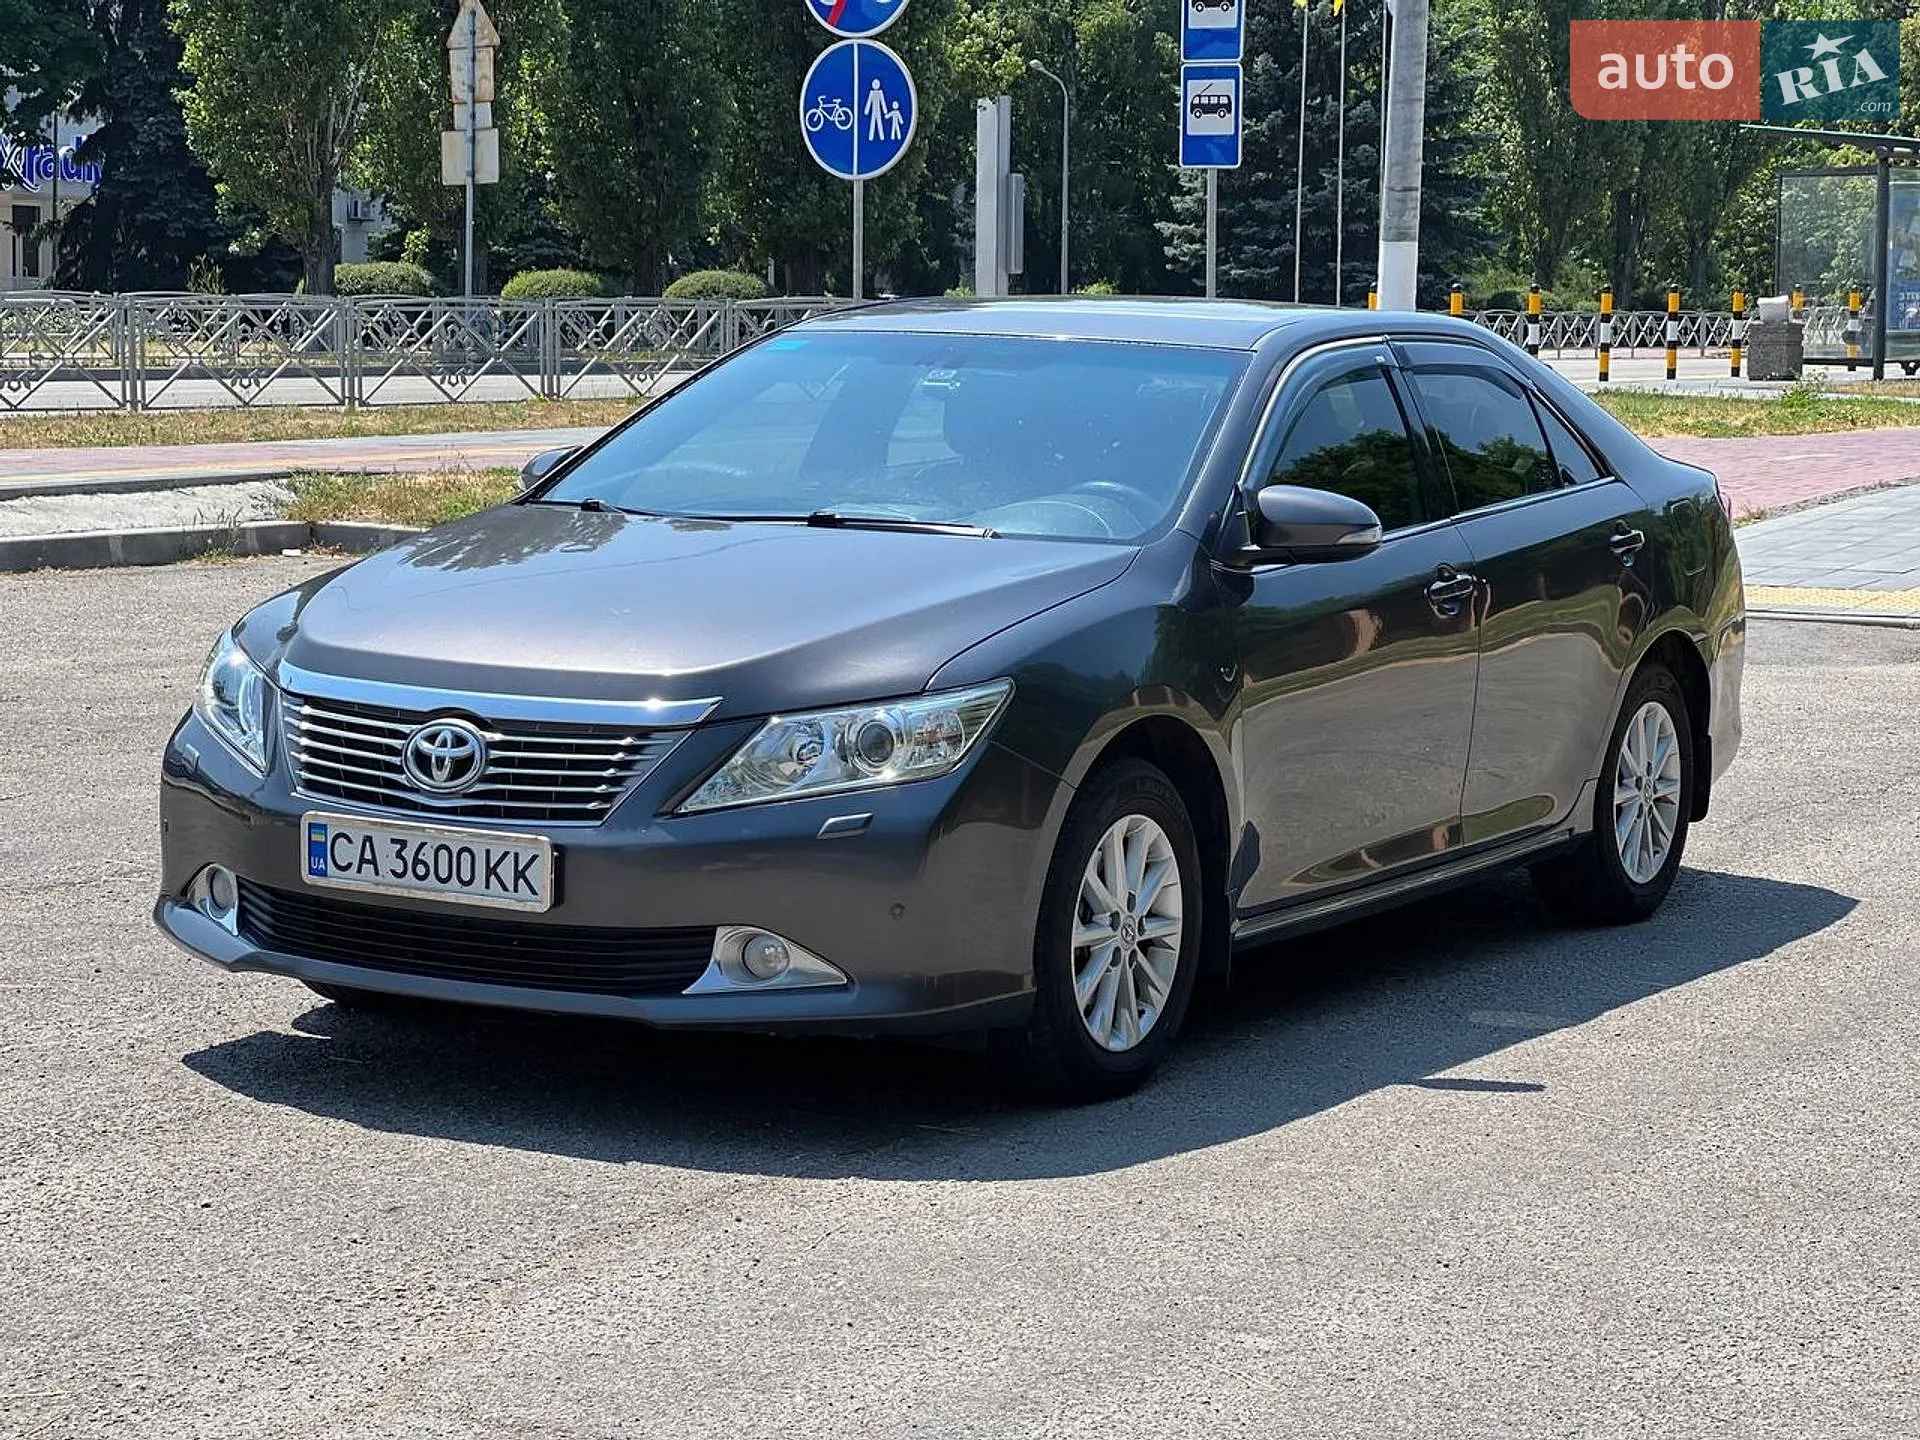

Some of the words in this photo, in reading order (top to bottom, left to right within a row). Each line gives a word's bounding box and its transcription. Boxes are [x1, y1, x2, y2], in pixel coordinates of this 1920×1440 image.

[310, 856, 326, 871] UA
[330, 832, 380, 876] CA
[390, 838, 476, 887] 3600
[484, 849, 540, 896] KK
